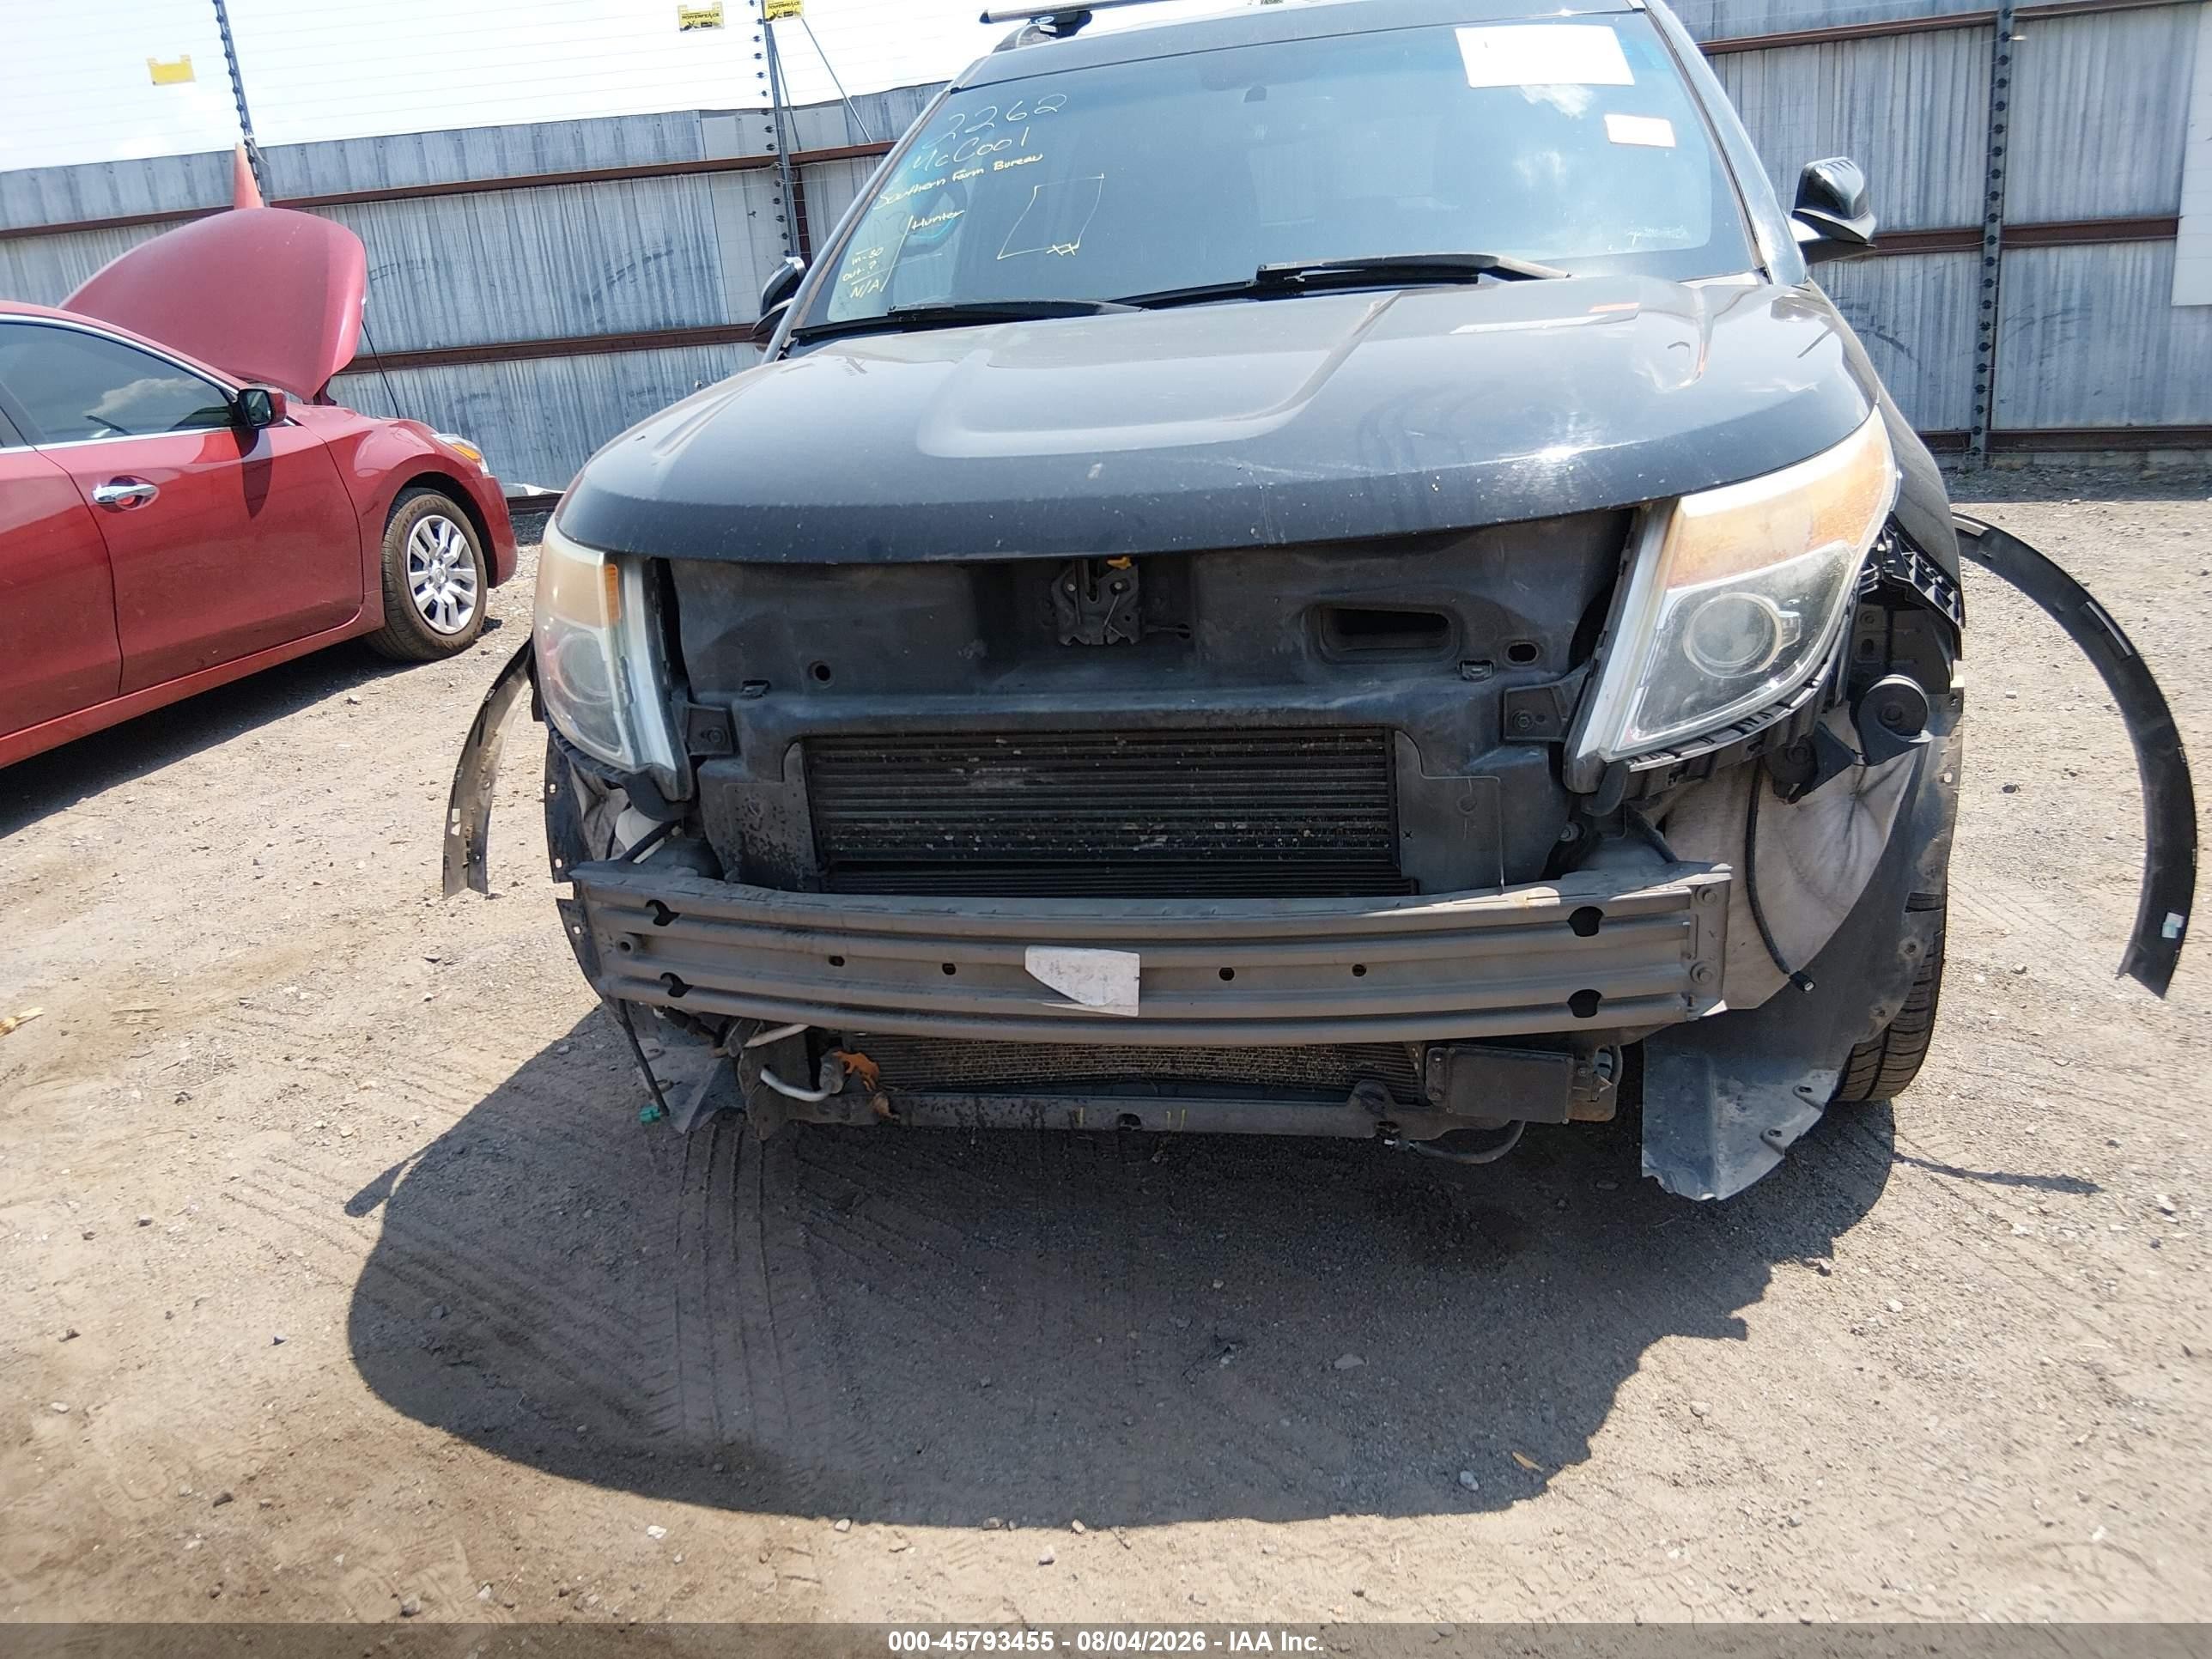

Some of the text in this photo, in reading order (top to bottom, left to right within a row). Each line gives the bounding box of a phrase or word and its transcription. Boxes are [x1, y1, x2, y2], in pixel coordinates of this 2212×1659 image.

[921, 93, 1067, 150] 2262
[951, 168, 985, 182] Farm
[993, 153, 1044, 172] Bureau
[850, 278, 879, 299] N/A
